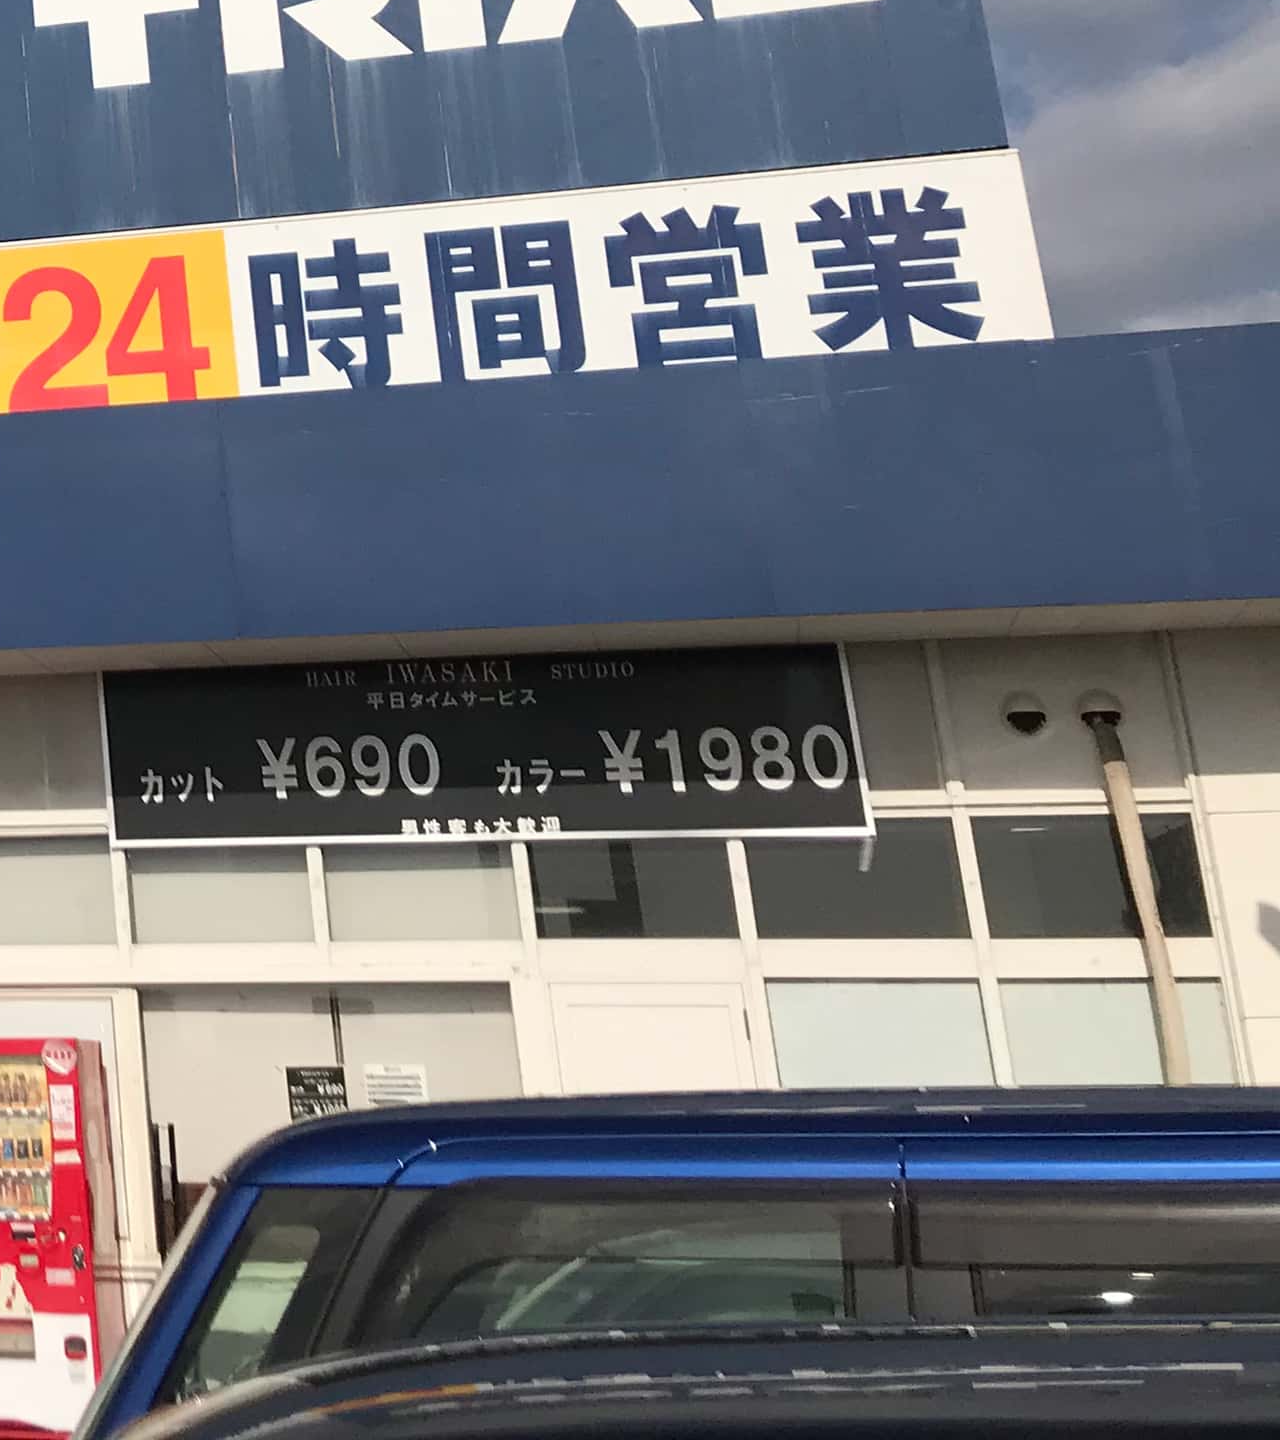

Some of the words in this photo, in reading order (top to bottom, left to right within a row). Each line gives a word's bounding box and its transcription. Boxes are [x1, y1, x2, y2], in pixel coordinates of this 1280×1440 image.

[305, 670, 358, 687] HAIR
[386, 660, 513, 685] IWASAKI
[550, 660, 635, 680] STUDIO
[367, 689, 538, 710] 平日タイムサービス
[140, 767, 225, 804] カット
[256, 733, 441, 801] ¥690
[495, 758, 587, 797] カラー
[598, 723, 847, 794] ¥1980
